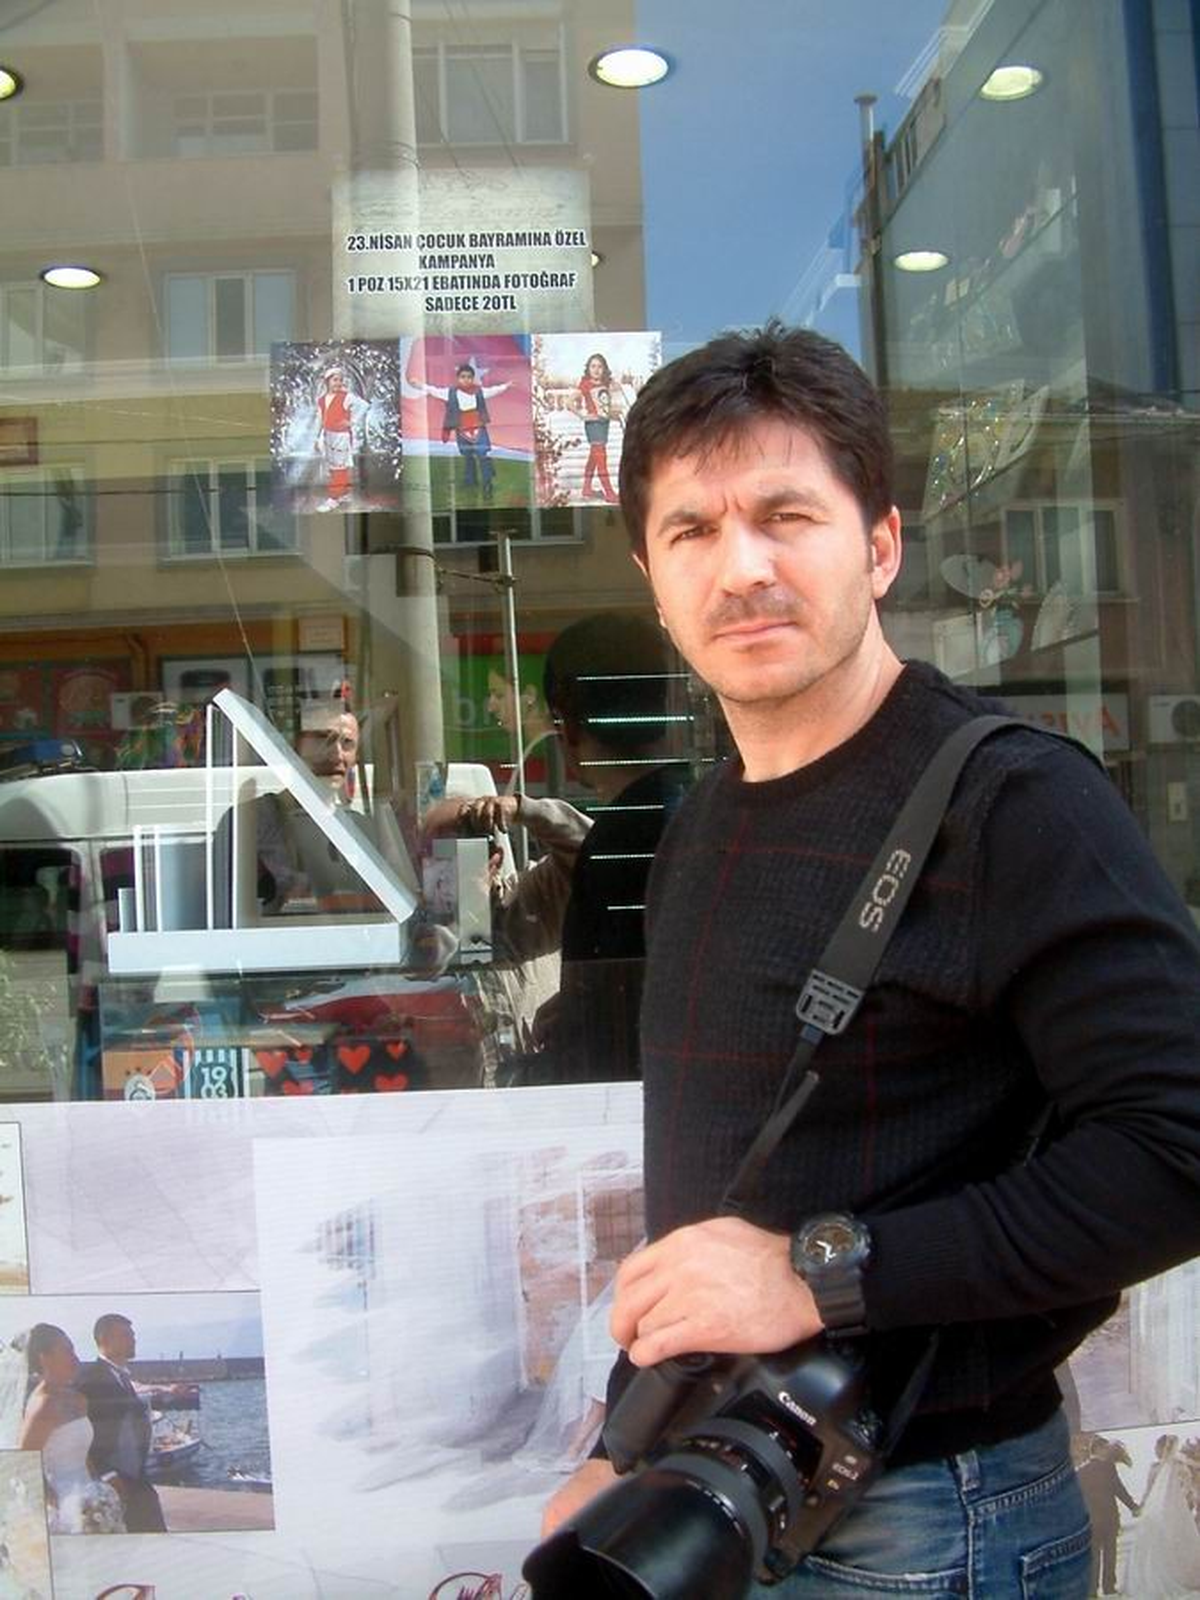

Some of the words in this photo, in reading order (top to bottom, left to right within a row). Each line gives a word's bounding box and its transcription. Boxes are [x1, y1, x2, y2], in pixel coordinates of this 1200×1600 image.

[347, 233, 412, 251] 23.NİSAN
[416, 232, 466, 252] ÇOCUK
[469, 231, 552, 249] BAYRAMINA
[555, 229, 586, 246] ÖZEL
[419, 253, 495, 269] KAMPANYA
[348, 277, 355, 292] 1
[358, 276, 385, 292] POZ
[387, 275, 429, 291] 15X21
[432, 273, 501, 291] EBATINDA
[504, 271, 576, 289] FOTOĞRAF
[425, 294, 479, 312] SADECE
[482, 294, 517, 311] 20TL
[859, 849, 911, 933] EOS
[201, 1066, 228, 1087] 19
[778, 1391, 817, 1427] Canon
